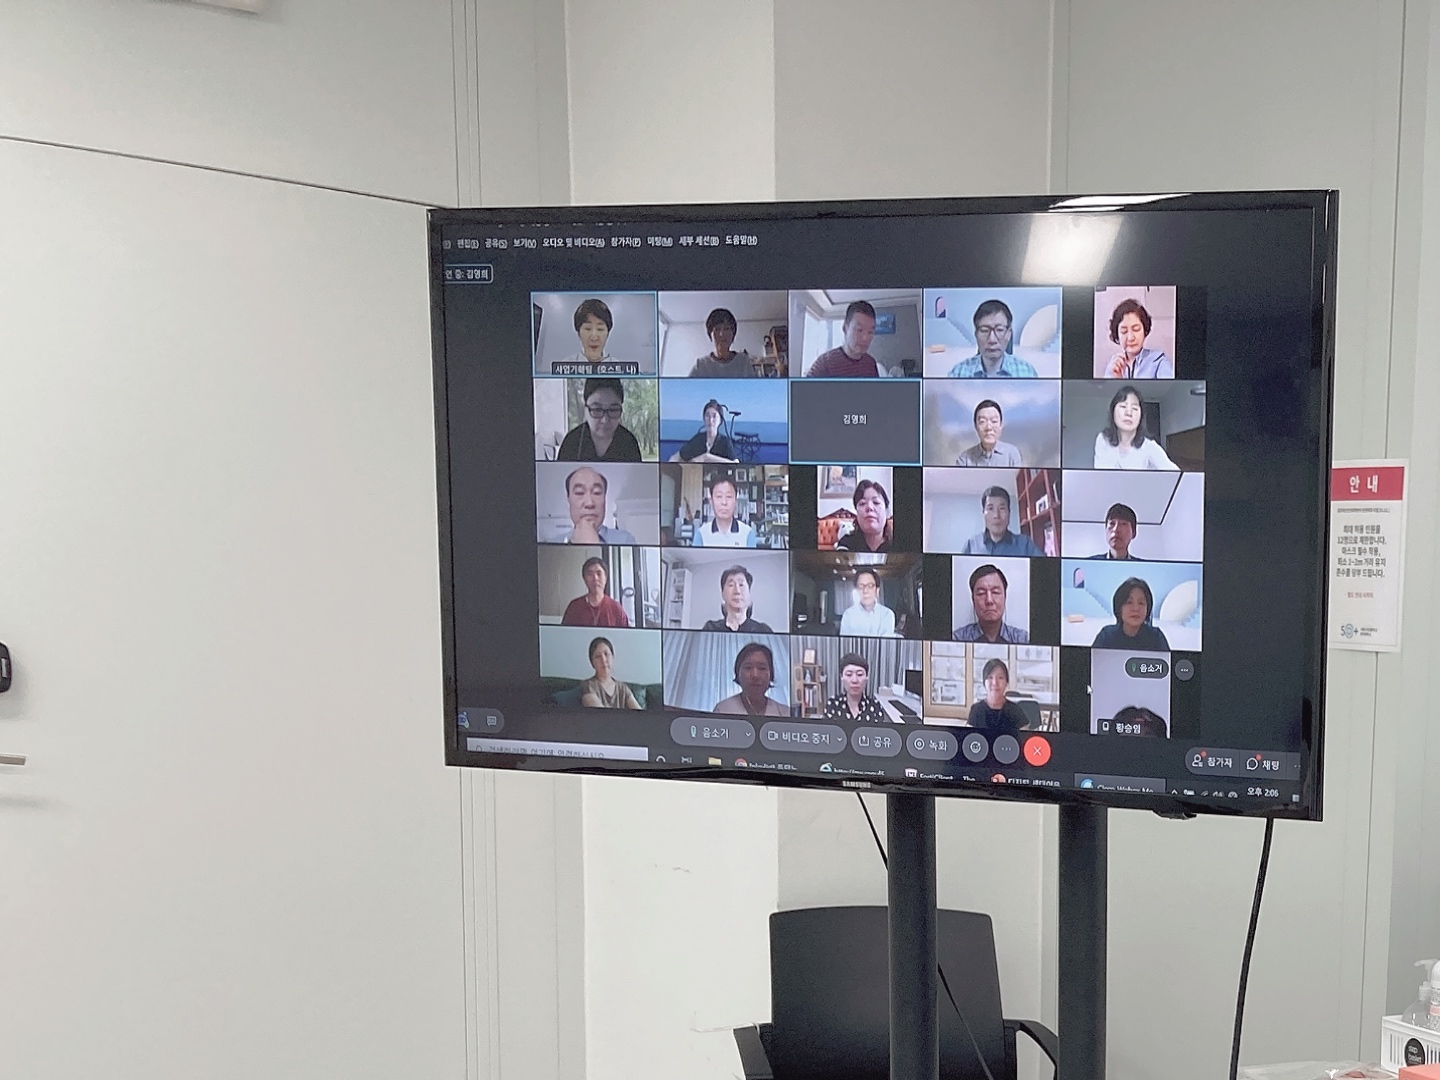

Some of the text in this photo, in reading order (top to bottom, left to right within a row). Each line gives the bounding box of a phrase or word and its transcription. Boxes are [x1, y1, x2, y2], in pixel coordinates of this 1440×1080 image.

[542, 238, 564, 247] 오디오
[843, 414, 867, 425] 김영희
[1140, 664, 1163, 673] 음소거
[782, 731, 830, 745] 비디오 중지
[874, 736, 892, 749] 공유
[929, 740, 947, 752] 녹화
[1207, 757, 1233, 769] 참가자
[1262, 759, 1280, 771] 채팅
[1247, 787, 1279, 798] 오후 2:06
